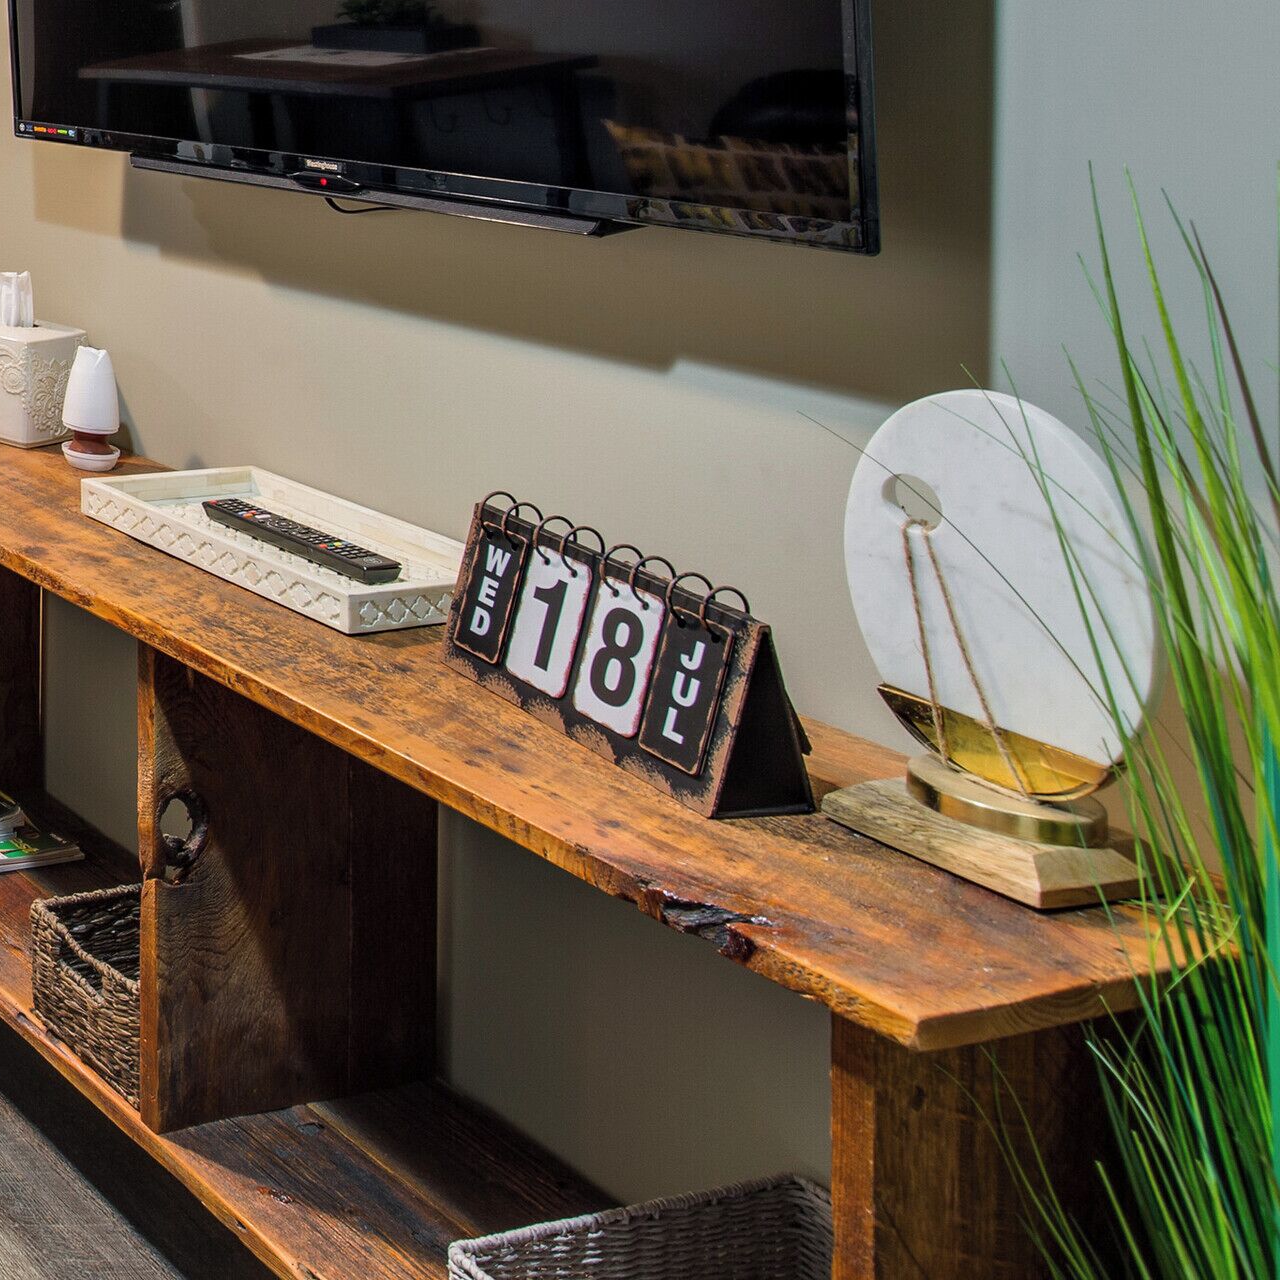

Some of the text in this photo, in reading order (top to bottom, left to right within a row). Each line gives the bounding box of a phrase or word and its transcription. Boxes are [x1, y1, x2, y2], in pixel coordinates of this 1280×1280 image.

[469, 543, 706, 745] WED 18 JUL
